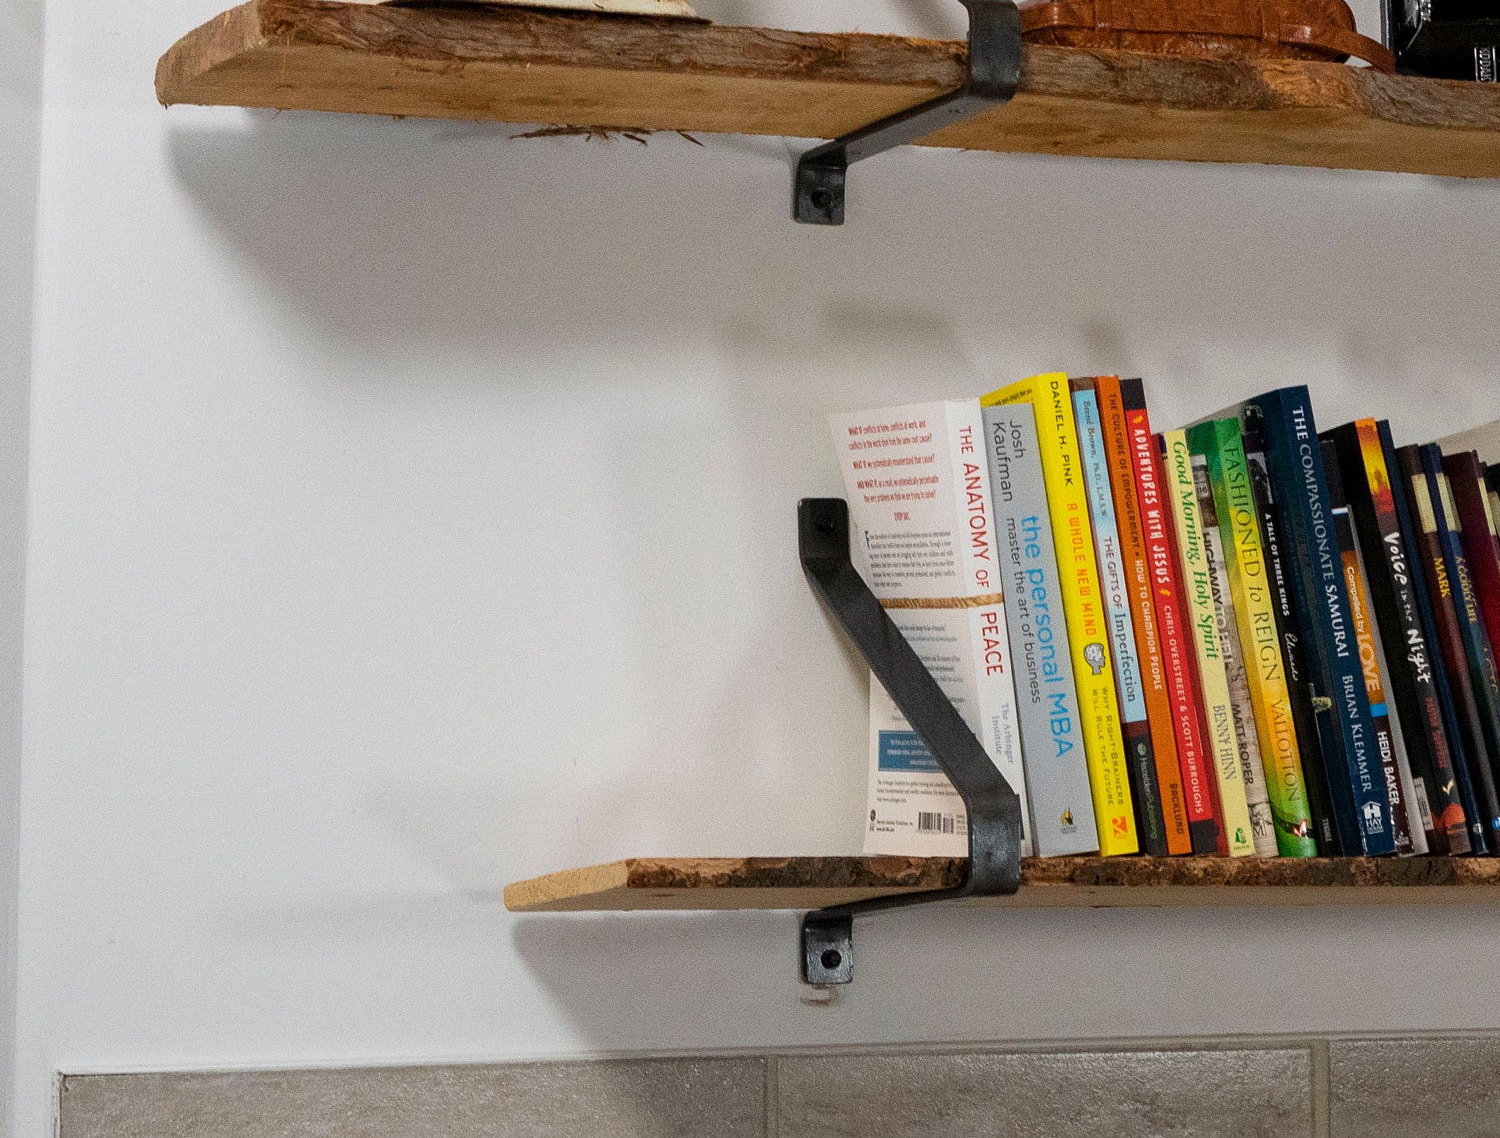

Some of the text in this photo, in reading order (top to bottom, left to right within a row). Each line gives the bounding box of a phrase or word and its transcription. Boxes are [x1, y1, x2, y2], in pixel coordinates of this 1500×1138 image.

[992, 422, 1013, 502] Kaufman
[1010, 420, 1024, 459] Josh
[1050, 381, 1074, 486] DANIEL H. PINK
[1133, 429, 1170, 584] ADVENTURES WITH JESUS
[1266, 523, 1276, 542] TALE
[1293, 406, 1350, 659] THE COMPASSIONATE SAMURAI
[959, 425, 1003, 676] THE ANATOMY OF PEACE
[1067, 502, 1097, 636] A WHOLE NEW MIND
[1172, 441, 1220, 660] Good Morning, Holy Spirit
[1224, 447, 1281, 681] FASHIONED to REIGN
[1271, 545, 1278, 557] OF
[1273, 559, 1284, 585] THREE
[1384, 532, 1407, 585] Voice
[1433, 557, 1451, 598] MARK
[1006, 517, 1041, 704] master the art of business
[1103, 536, 1136, 702] THE GIFTS OF Imperfection
[1214, 605, 1227, 628] TO
[1277, 587, 1290, 616] KINGS
[1403, 603, 1413, 622] the
[1458, 565, 1477, 607] GODLY
[1466, 604, 1477, 624] LIFE
[1021, 515, 1074, 758] the personal MBA
[1163, 605, 1175, 636] CHRIS
[1219, 629, 1234, 665] HELL
[1347, 566, 1381, 692] Compelled by LOVE
[1169, 638, 1186, 701] OVERSTREET
[1407, 629, 1431, 684] Night
[1001, 702, 1009, 722] The
[1102, 686, 1110, 710] WHY
[1181, 714, 1193, 745] SCOTT
[1092, 689, 1114, 806] WILL RULE THE FUTURE
[1213, 704, 1237, 780] BENNY HINN
[1231, 703, 1254, 785] MATT ROPER
[1270, 699, 1300, 802] VALLOTTON
[1342, 675, 1373, 793] BRIAN KLEMMER
[1186, 748, 1204, 814] BURROUGHS
[1377, 731, 1400, 805] HEIDI BAKER
